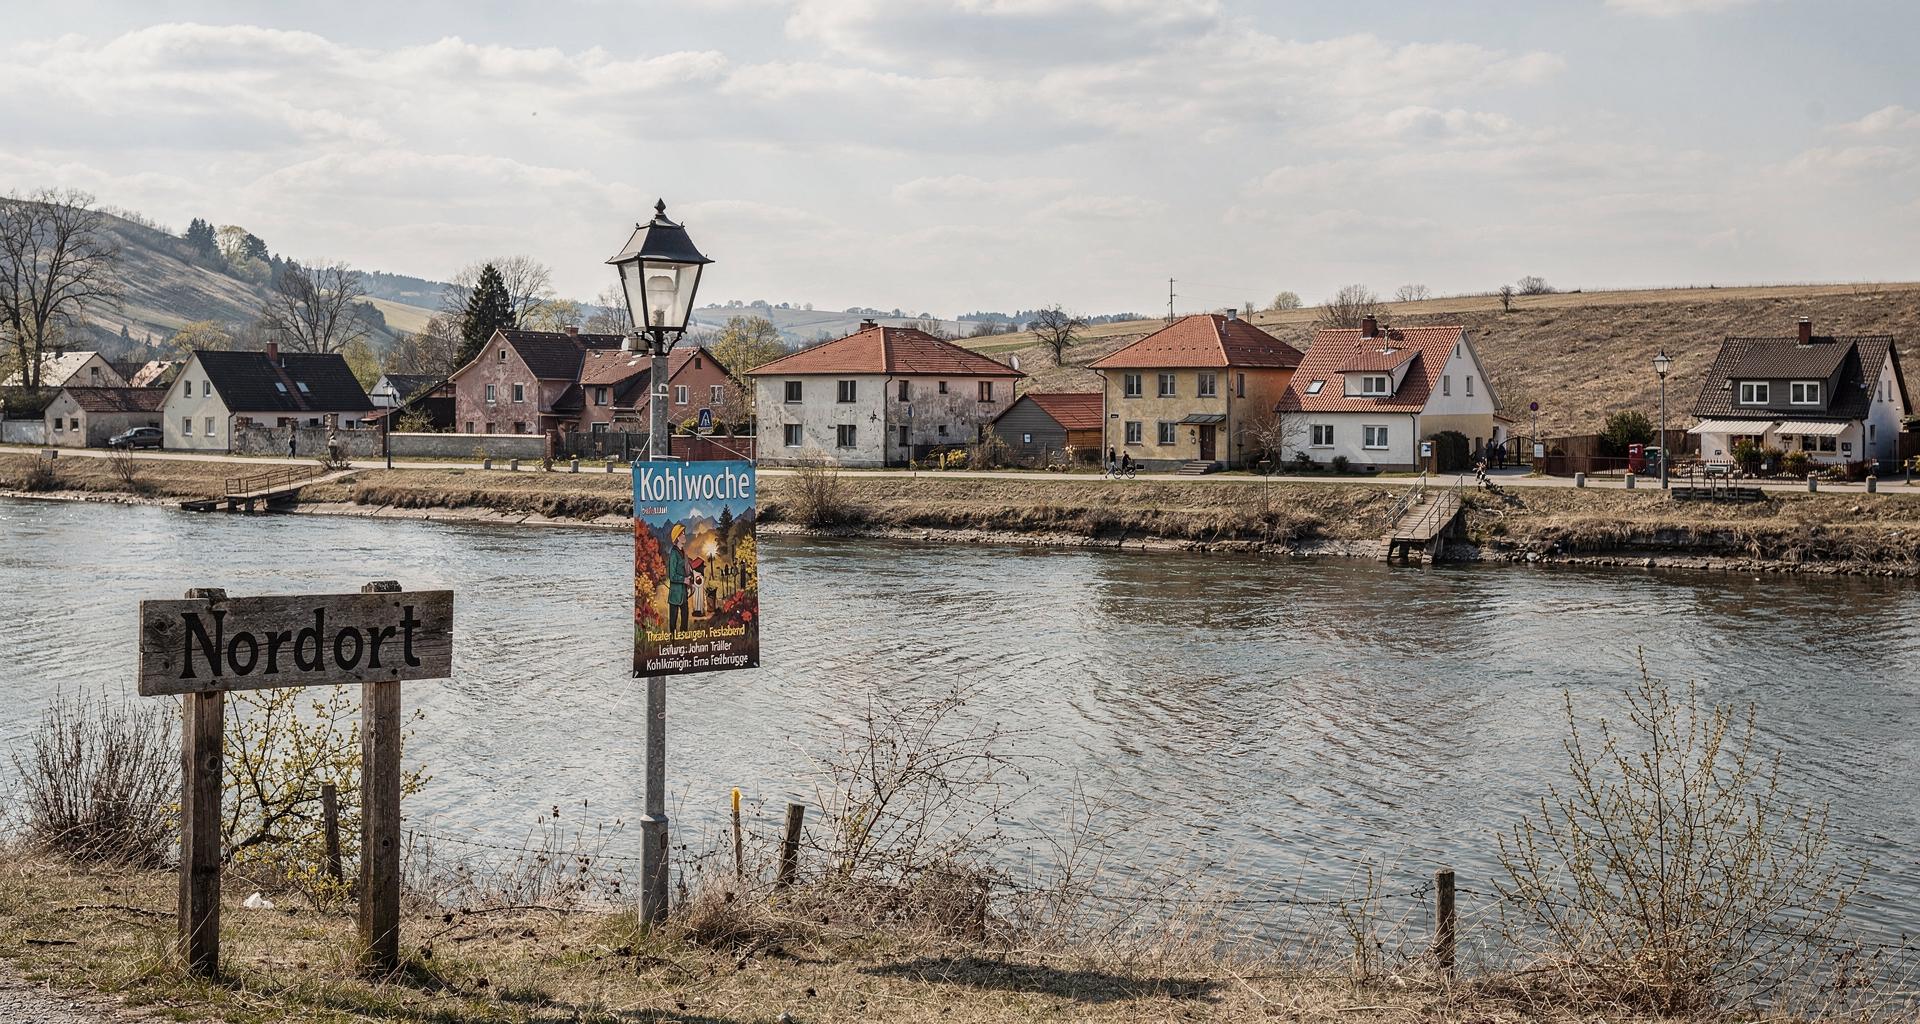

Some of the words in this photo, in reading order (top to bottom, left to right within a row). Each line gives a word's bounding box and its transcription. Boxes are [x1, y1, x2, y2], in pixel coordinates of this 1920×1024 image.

[640, 466, 750, 501] Kohlwoche
[179, 605, 422, 679] Nordort
[709, 624, 745, 638] Festabend
